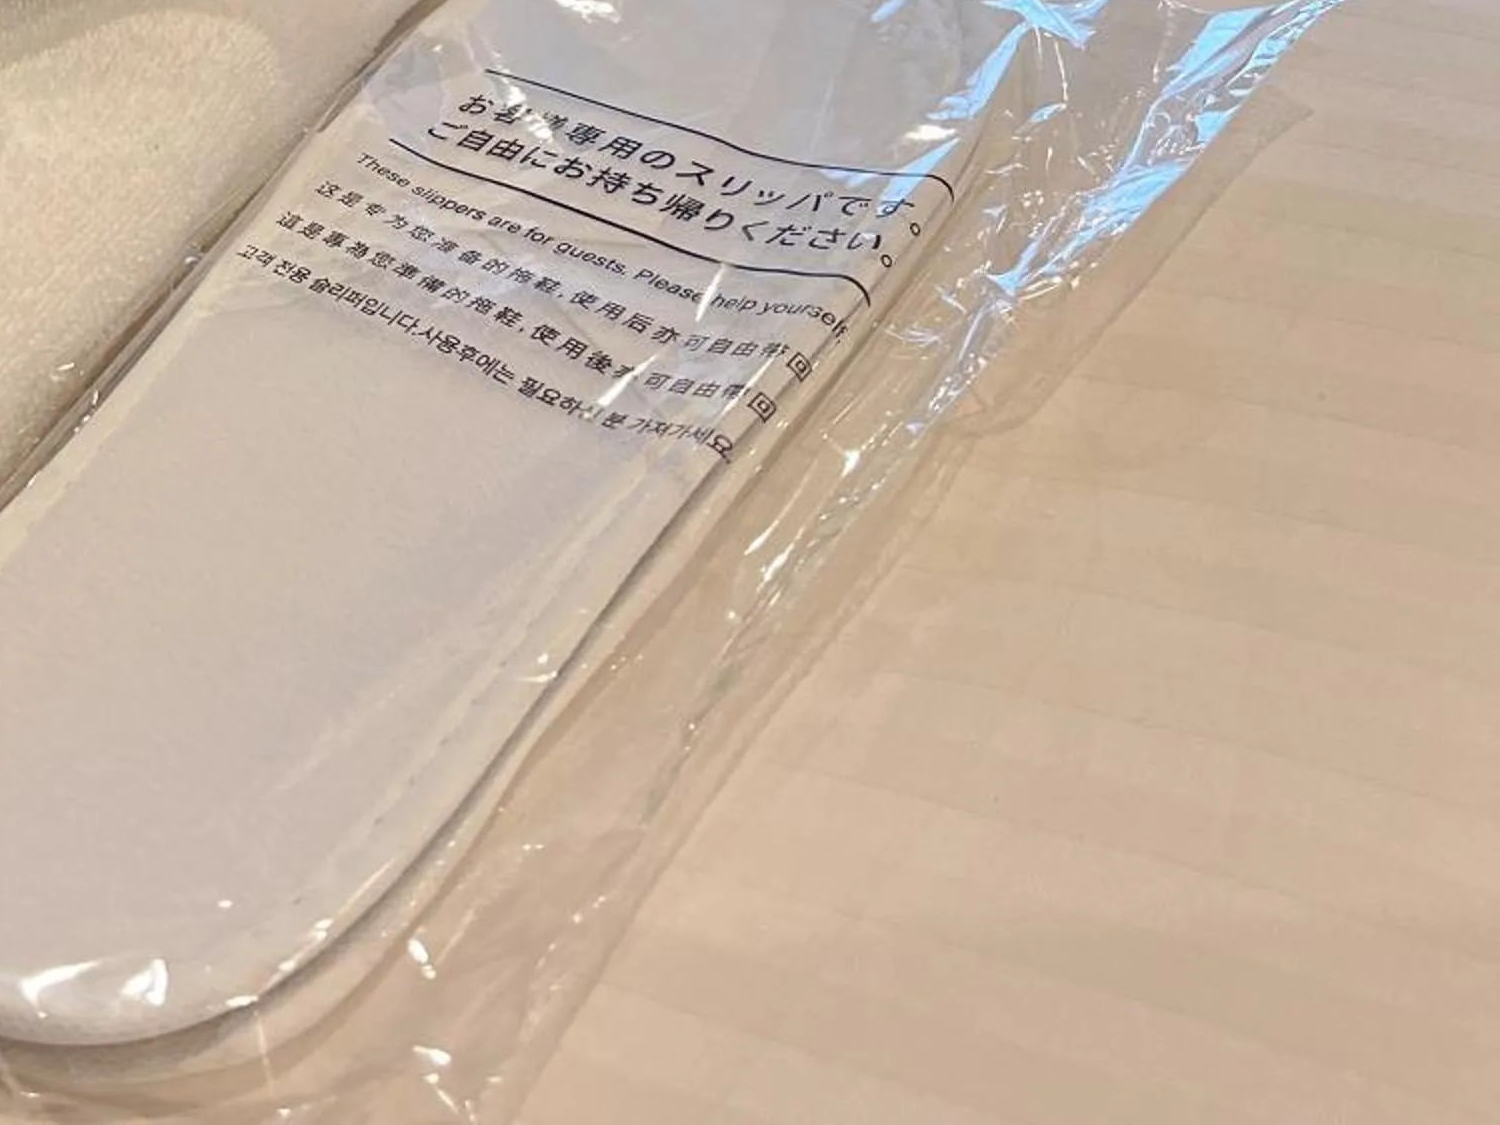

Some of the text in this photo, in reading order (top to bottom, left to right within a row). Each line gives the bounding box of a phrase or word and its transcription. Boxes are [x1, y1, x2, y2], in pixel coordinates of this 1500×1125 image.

[236, 244, 276, 268] 고객
[273, 259, 312, 284] 전용
[356, 152, 410, 188] These
[412, 184, 487, 222] slippers
[487, 215, 522, 235] are
[523, 225, 552, 246] for
[553, 240, 628, 277] guests.
[633, 268, 706, 303] Please
[709, 292, 758, 316] help
[427, 121, 893, 268] ご自由にお持ち帰りください。
